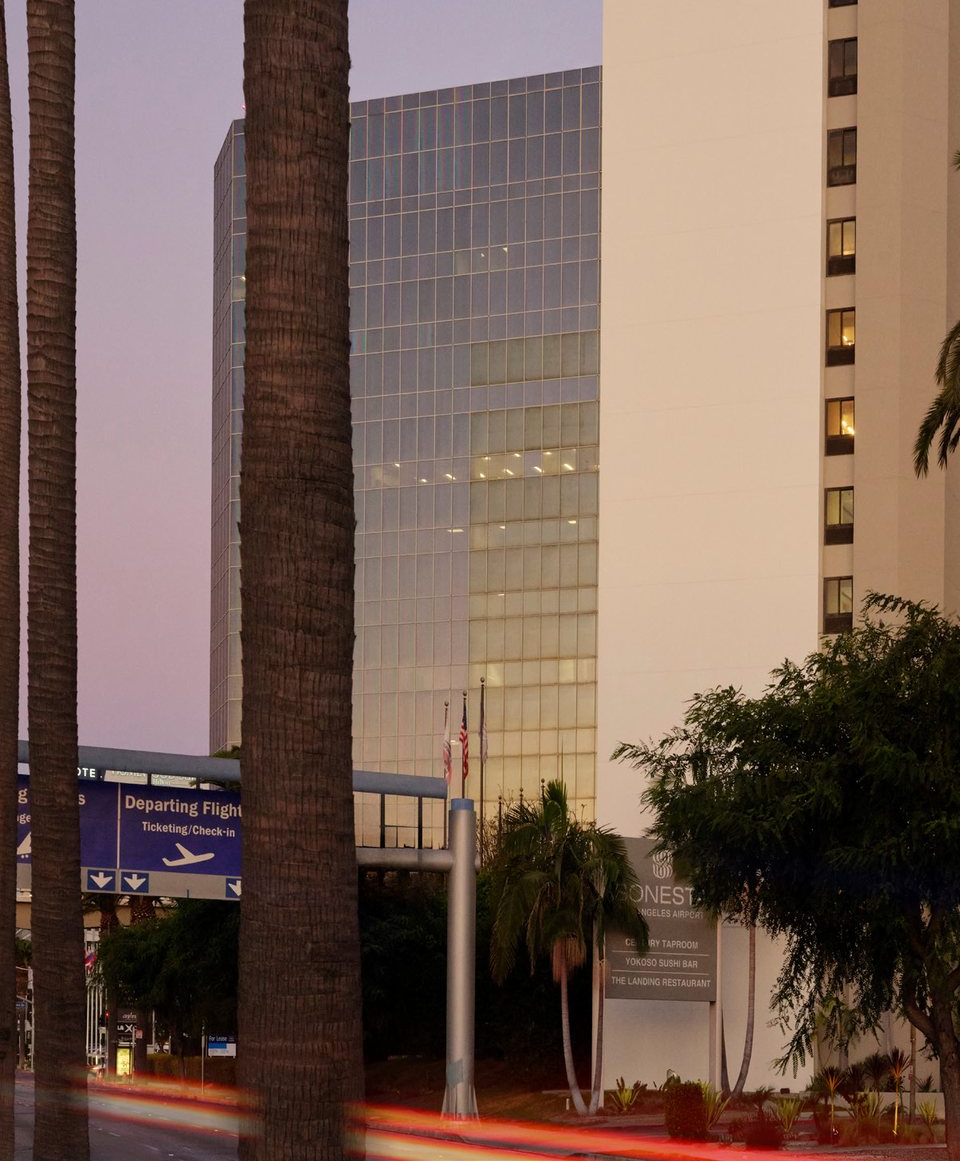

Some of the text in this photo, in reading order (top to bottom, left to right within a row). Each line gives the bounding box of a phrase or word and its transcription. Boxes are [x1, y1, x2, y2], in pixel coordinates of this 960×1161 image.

[125, 795, 242, 820] Departing Flight
[142, 821, 236, 838] Ticketing/Check-in
[629, 884, 695, 906] ONEST
[638, 908, 671, 918] NGELES
[662, 939, 699, 950] TAPROOM
[625, 957, 698, 968] YOKOSO SUSHI BAR
[612, 976, 711, 988] THE LANDING RESTAURANT
